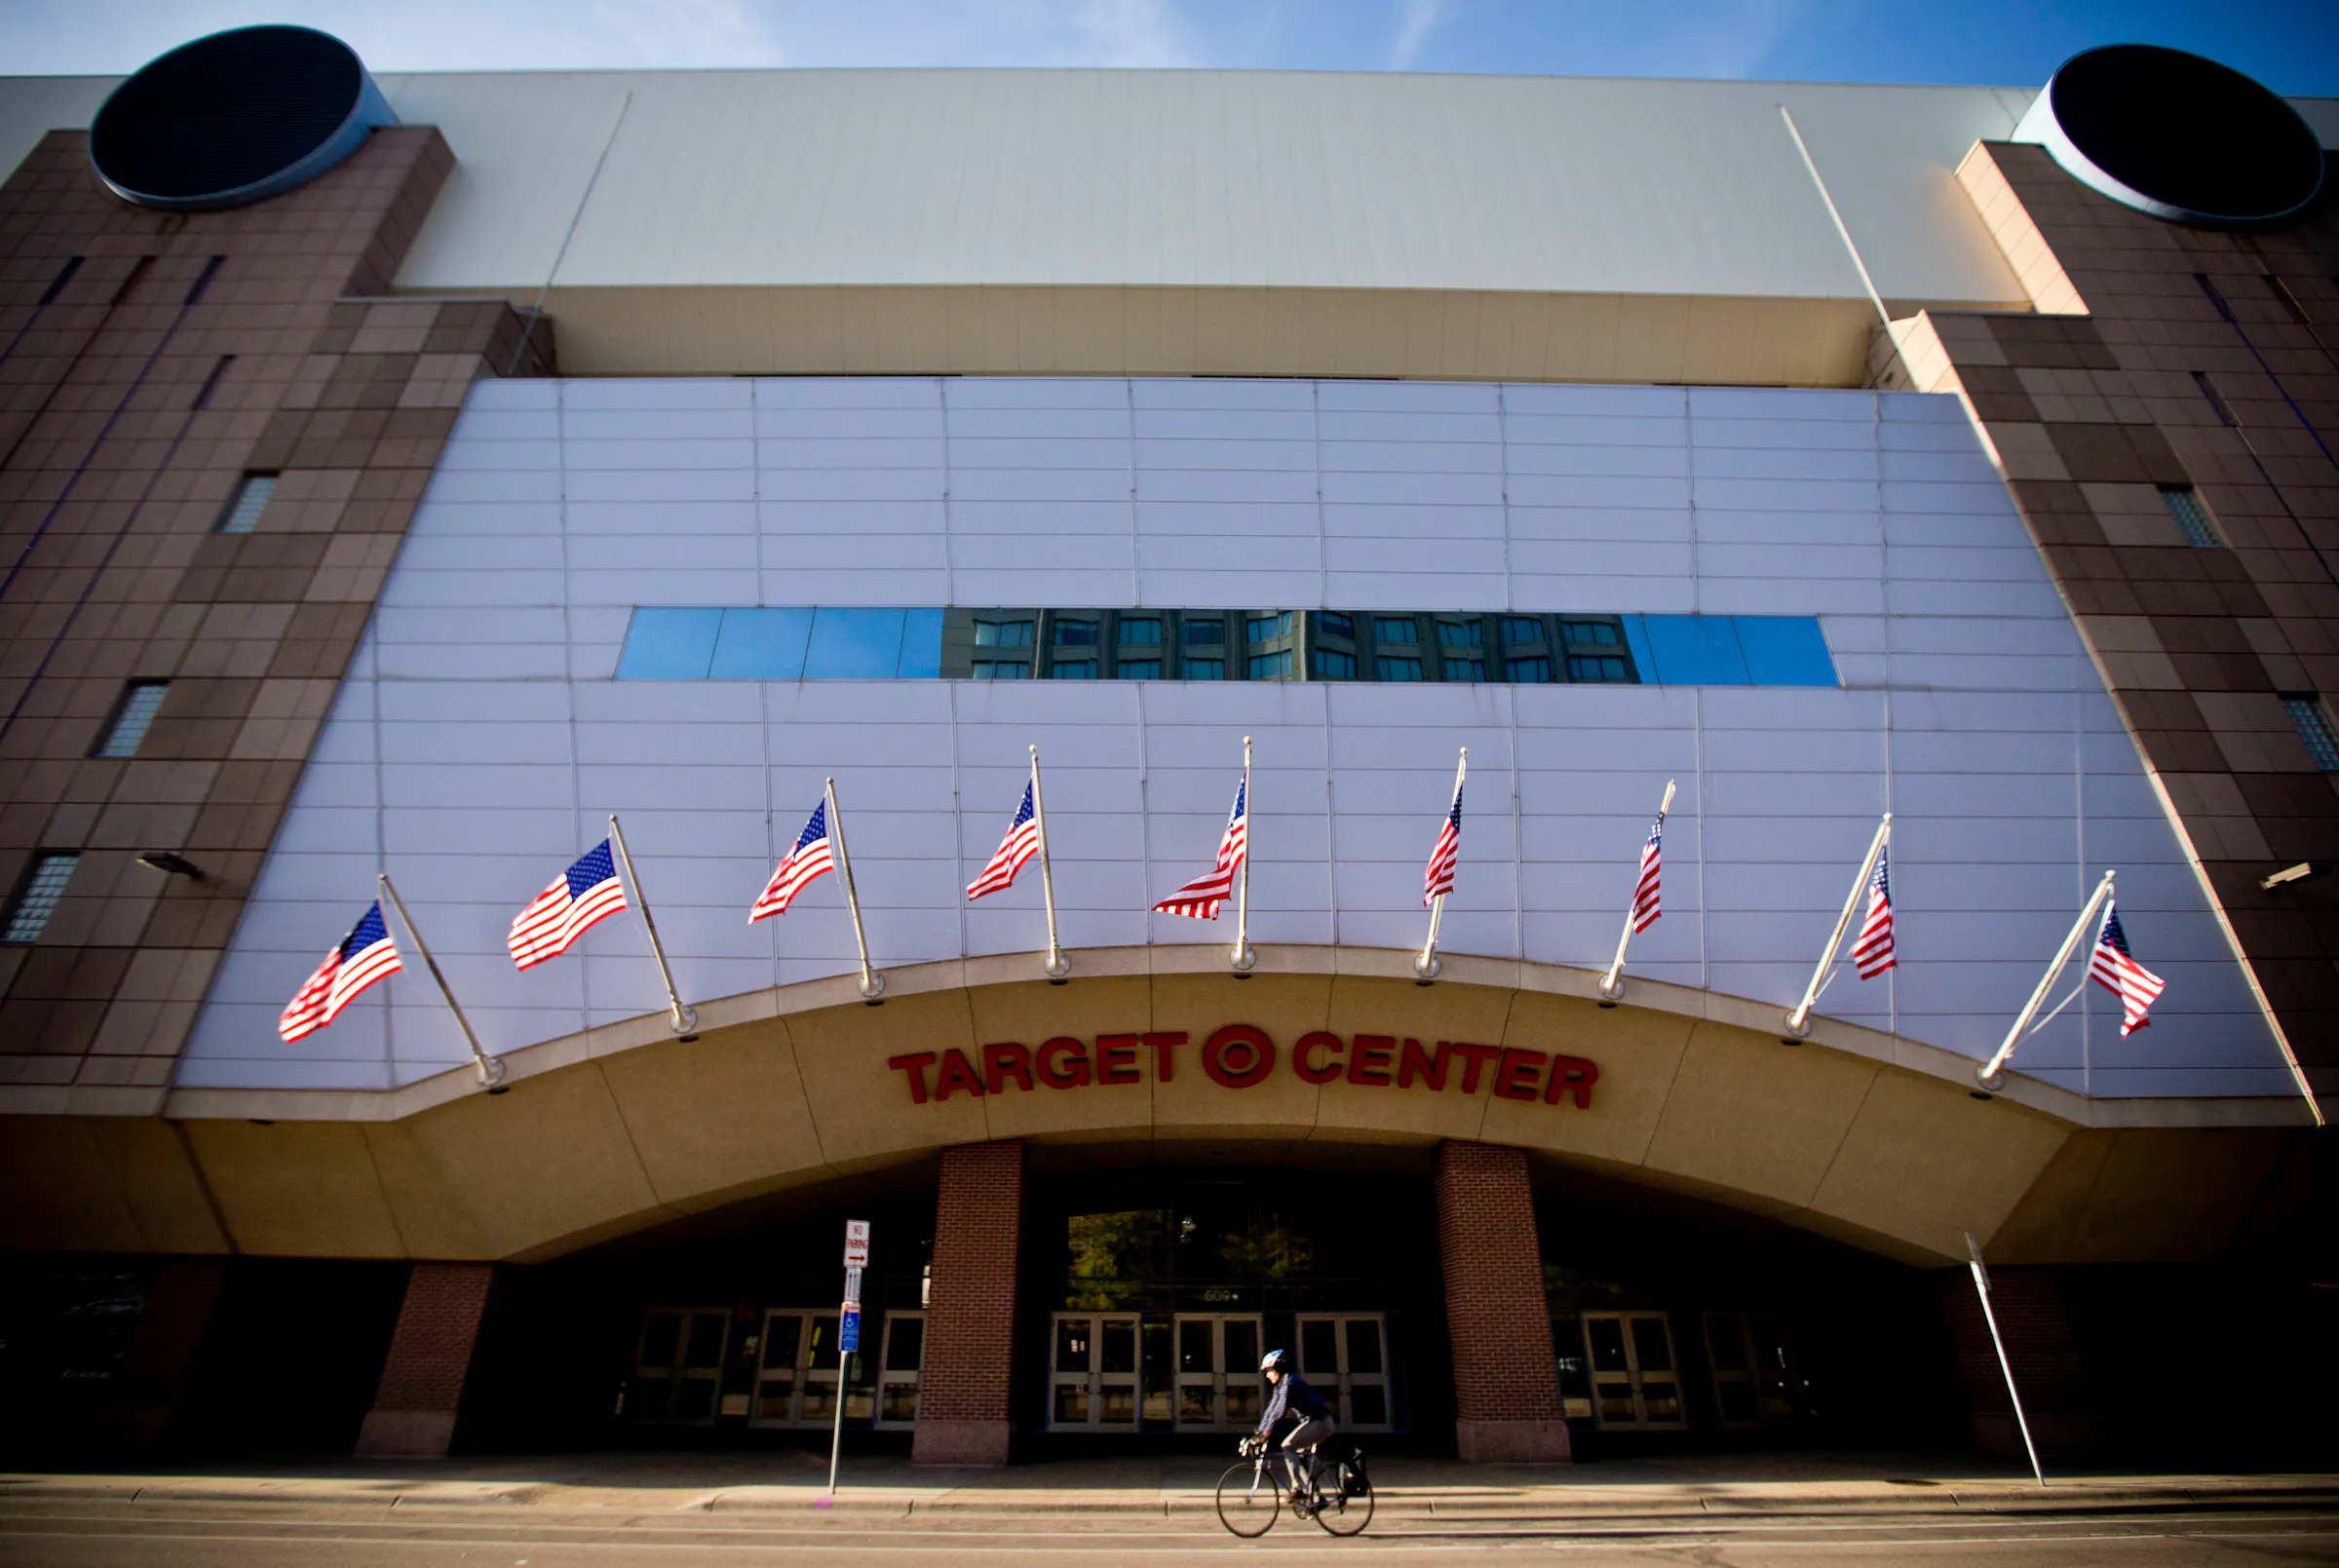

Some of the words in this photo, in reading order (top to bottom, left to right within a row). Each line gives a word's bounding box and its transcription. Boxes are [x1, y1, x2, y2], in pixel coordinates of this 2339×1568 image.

[888, 1031, 1189, 1104] TARGET
[1292, 1031, 1599, 1110] CENTER
[854, 1225, 863, 1236] NO
[847, 1239, 868, 1249] PARKING
